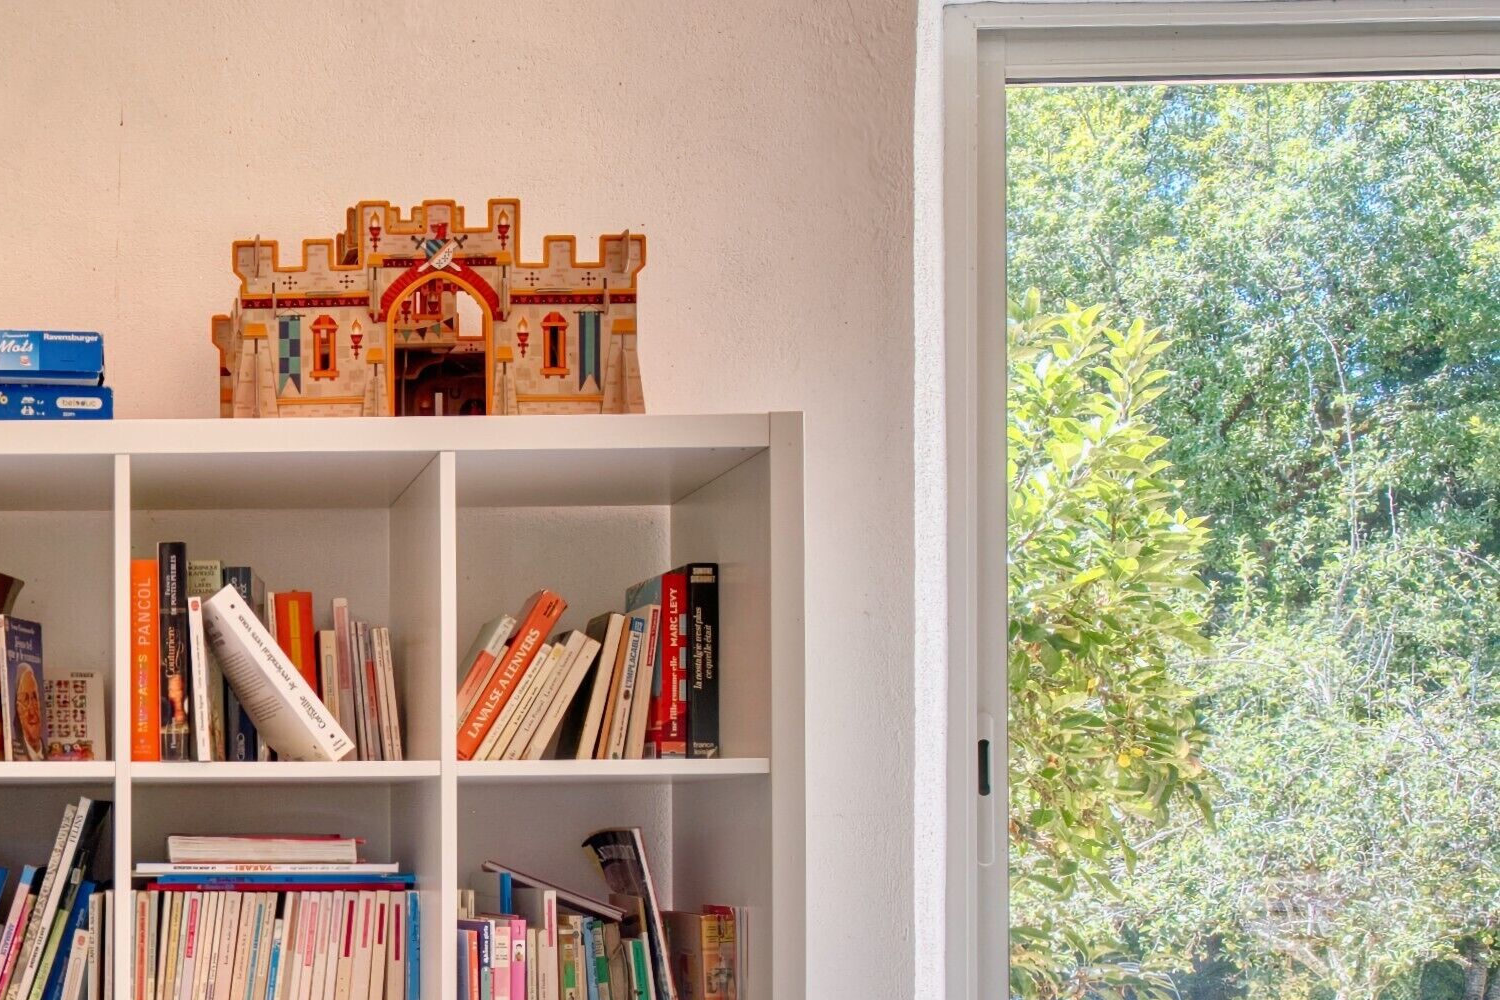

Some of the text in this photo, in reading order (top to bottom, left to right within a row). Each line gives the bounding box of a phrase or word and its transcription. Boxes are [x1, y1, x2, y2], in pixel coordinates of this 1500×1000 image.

[43, 333, 99, 343] Ravensburger
[169, 581, 177, 605] PONTES
[136, 576, 152, 645] PANCOL
[669, 587, 678, 647] MARC LEVY
[236, 613, 253, 633] vous
[249, 630, 264, 647] vers
[692, 606, 703, 689] la nostalgie n'est plus
[164, 625, 175, 678] Couturière
[622, 632, 642, 689] L'IMPLACABLE
[703, 624, 713, 678] ce qu'elle était
[259, 644, 292, 684] reviendrai
[669, 654, 677, 671] elle
[286, 680, 297, 691] Je
[296, 693, 327, 731] Cornaille
[475, 685, 504, 724] VALSE
[669, 701, 677, 720] fille
[466, 718, 485, 739] LA
[669, 719, 677, 736] Une
[89, 925, 95, 935] LA
[89, 936, 95, 944] ET
